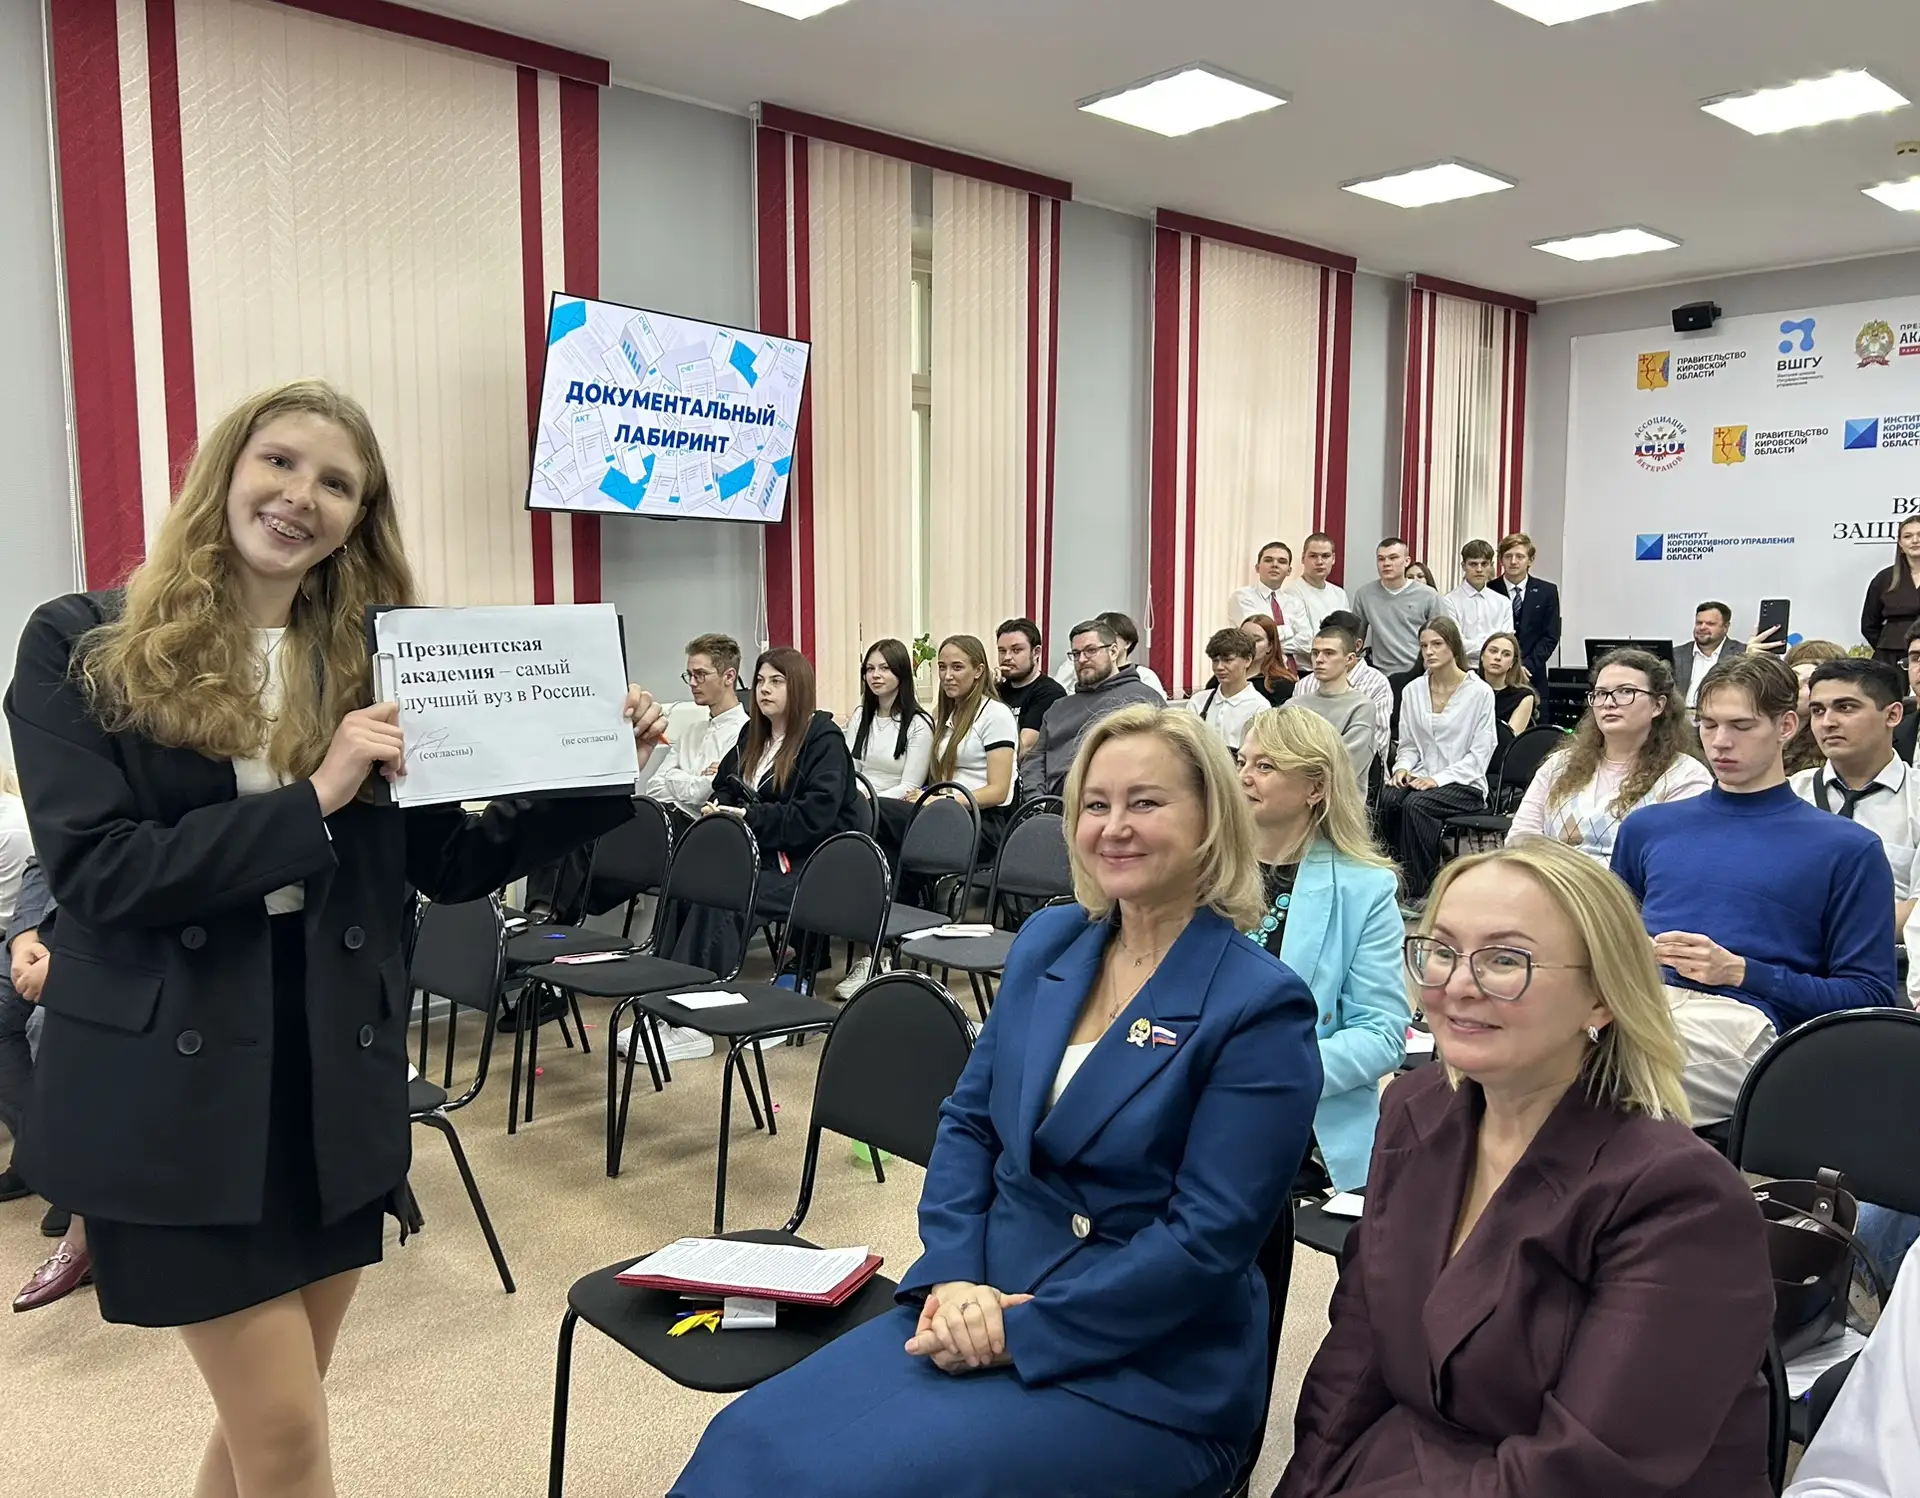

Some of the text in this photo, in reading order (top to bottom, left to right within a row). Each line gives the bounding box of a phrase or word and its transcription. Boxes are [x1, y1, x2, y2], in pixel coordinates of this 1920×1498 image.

[1900, 331, 1920, 344] АК
[1677, 351, 1747, 365] ПРАВИТЕЛЬСТВО
[1777, 356, 1823, 371] ВШГУ
[1677, 360, 1727, 373] КИРОВСКОЙ
[1676, 370, 1715, 380] ОБЛАСТИ
[565, 381, 775, 427] ДОКУМЕНТАЛЬНЫЙ
[1634, 416, 1687, 438] АССОЦИАЦИЯ
[1755, 428, 1829, 440] ПРАВИТЕЛЬСТВО
[614, 424, 730, 454] ЛАБИРИНТ
[1754, 437, 1808, 447] КИРОВСКОЙ
[1641, 440, 1679, 455] СВО
[1754, 446, 1795, 455] ОБЛАСТИ
[1636, 456, 1683, 472] ВЕТЕРАНОВ
[1667, 532, 1708, 540] ИНСТИТУТ
[1667, 537, 1795, 546] КОРПОРАТИВНОГО УПРАВЛЕНИЯ
[1667, 545, 1714, 553] КИРОВСКОЙ
[1666, 553, 1703, 561] ОБЛАСТИ
[397, 639, 543, 662] Президентская
[401, 666, 495, 684] академия
[516, 659, 571, 677] самый
[404, 684, 596, 714] лучший вуз в России.
[562, 732, 619, 747] (не согласны)
[419, 747, 474, 761] (согласны)
